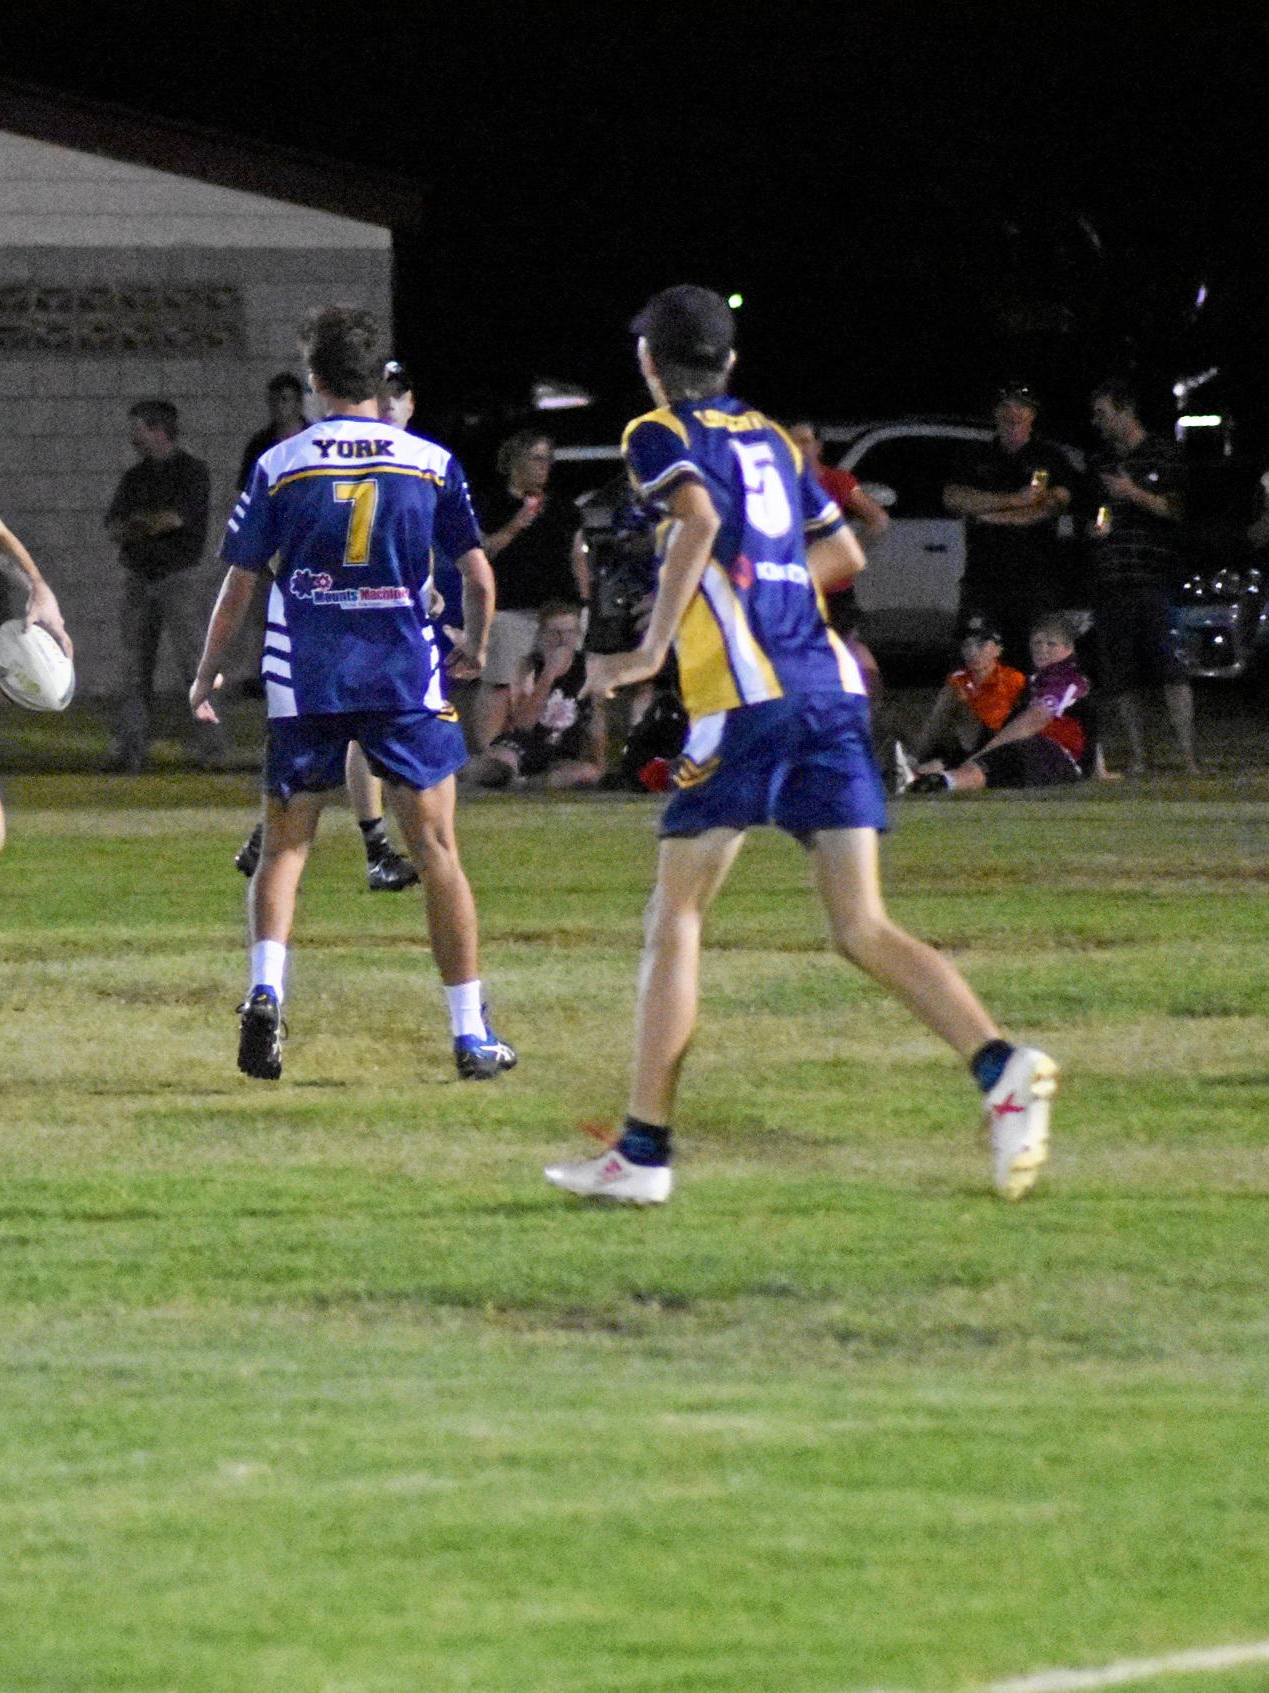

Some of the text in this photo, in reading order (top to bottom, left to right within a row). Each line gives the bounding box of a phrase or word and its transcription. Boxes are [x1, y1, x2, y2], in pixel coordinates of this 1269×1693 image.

[312, 439, 395, 458] YORK
[730, 439, 792, 538] 5
[333, 479, 378, 566] 7
